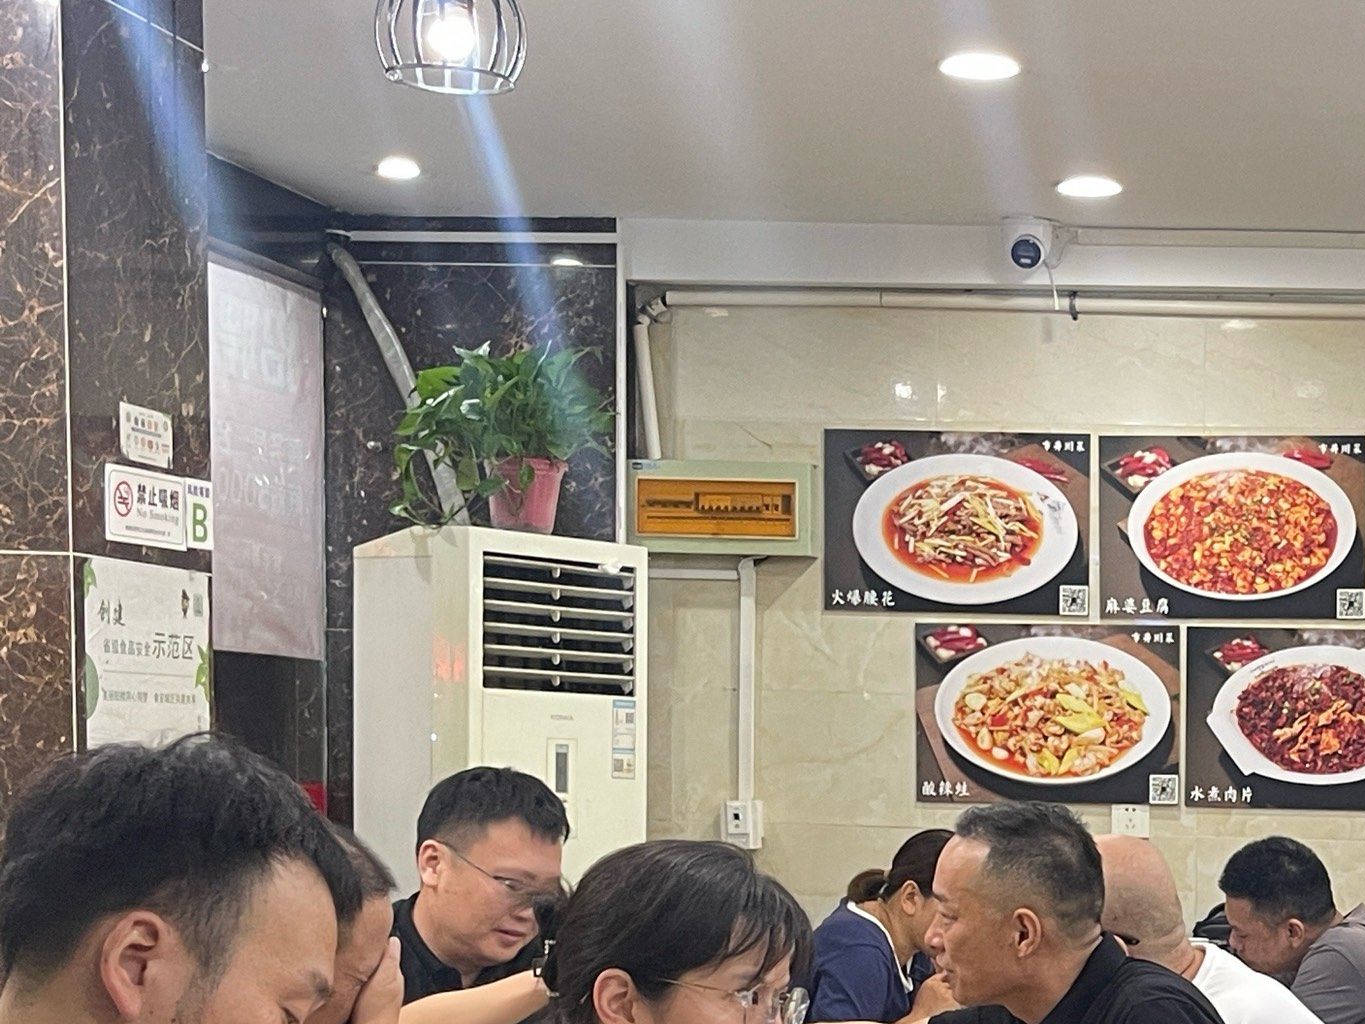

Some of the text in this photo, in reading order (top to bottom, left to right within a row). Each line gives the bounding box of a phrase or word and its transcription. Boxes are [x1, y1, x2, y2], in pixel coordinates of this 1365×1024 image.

[136, 483, 179, 511] 禁止吸烟
[192, 502, 208, 543] B
[99, 600, 126, 626] 创建
[1105, 597, 1169, 615] 麻婆豆腐
[1189, 785, 1253, 803] 水煮肉片
